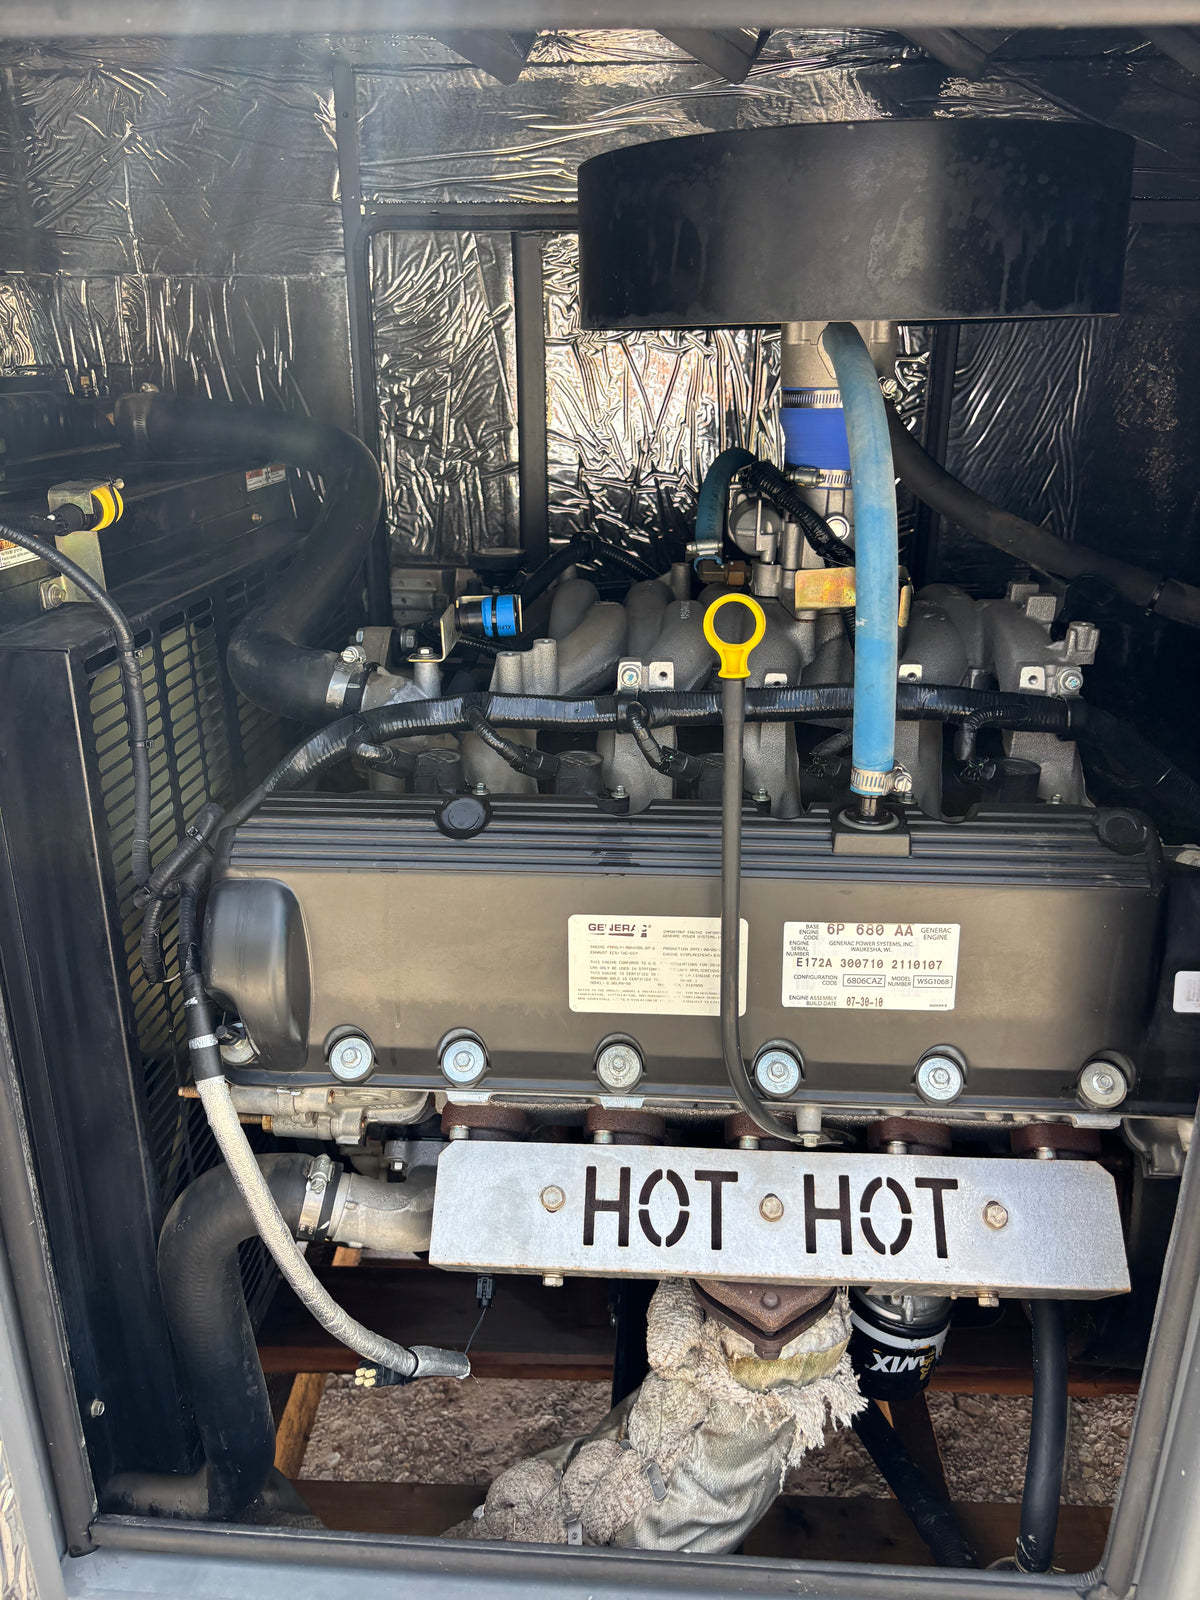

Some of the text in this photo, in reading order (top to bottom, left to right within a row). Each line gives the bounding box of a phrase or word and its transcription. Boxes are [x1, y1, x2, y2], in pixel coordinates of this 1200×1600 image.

[827, 924, 914, 936] 6P 680 AA
[796, 957, 943, 970] E172A 300710 2110107
[846, 977, 884, 985] 6806CAZ
[846, 996, 884, 1007] 07-30-10
[583, 1166, 959, 1259] HOT HOT
